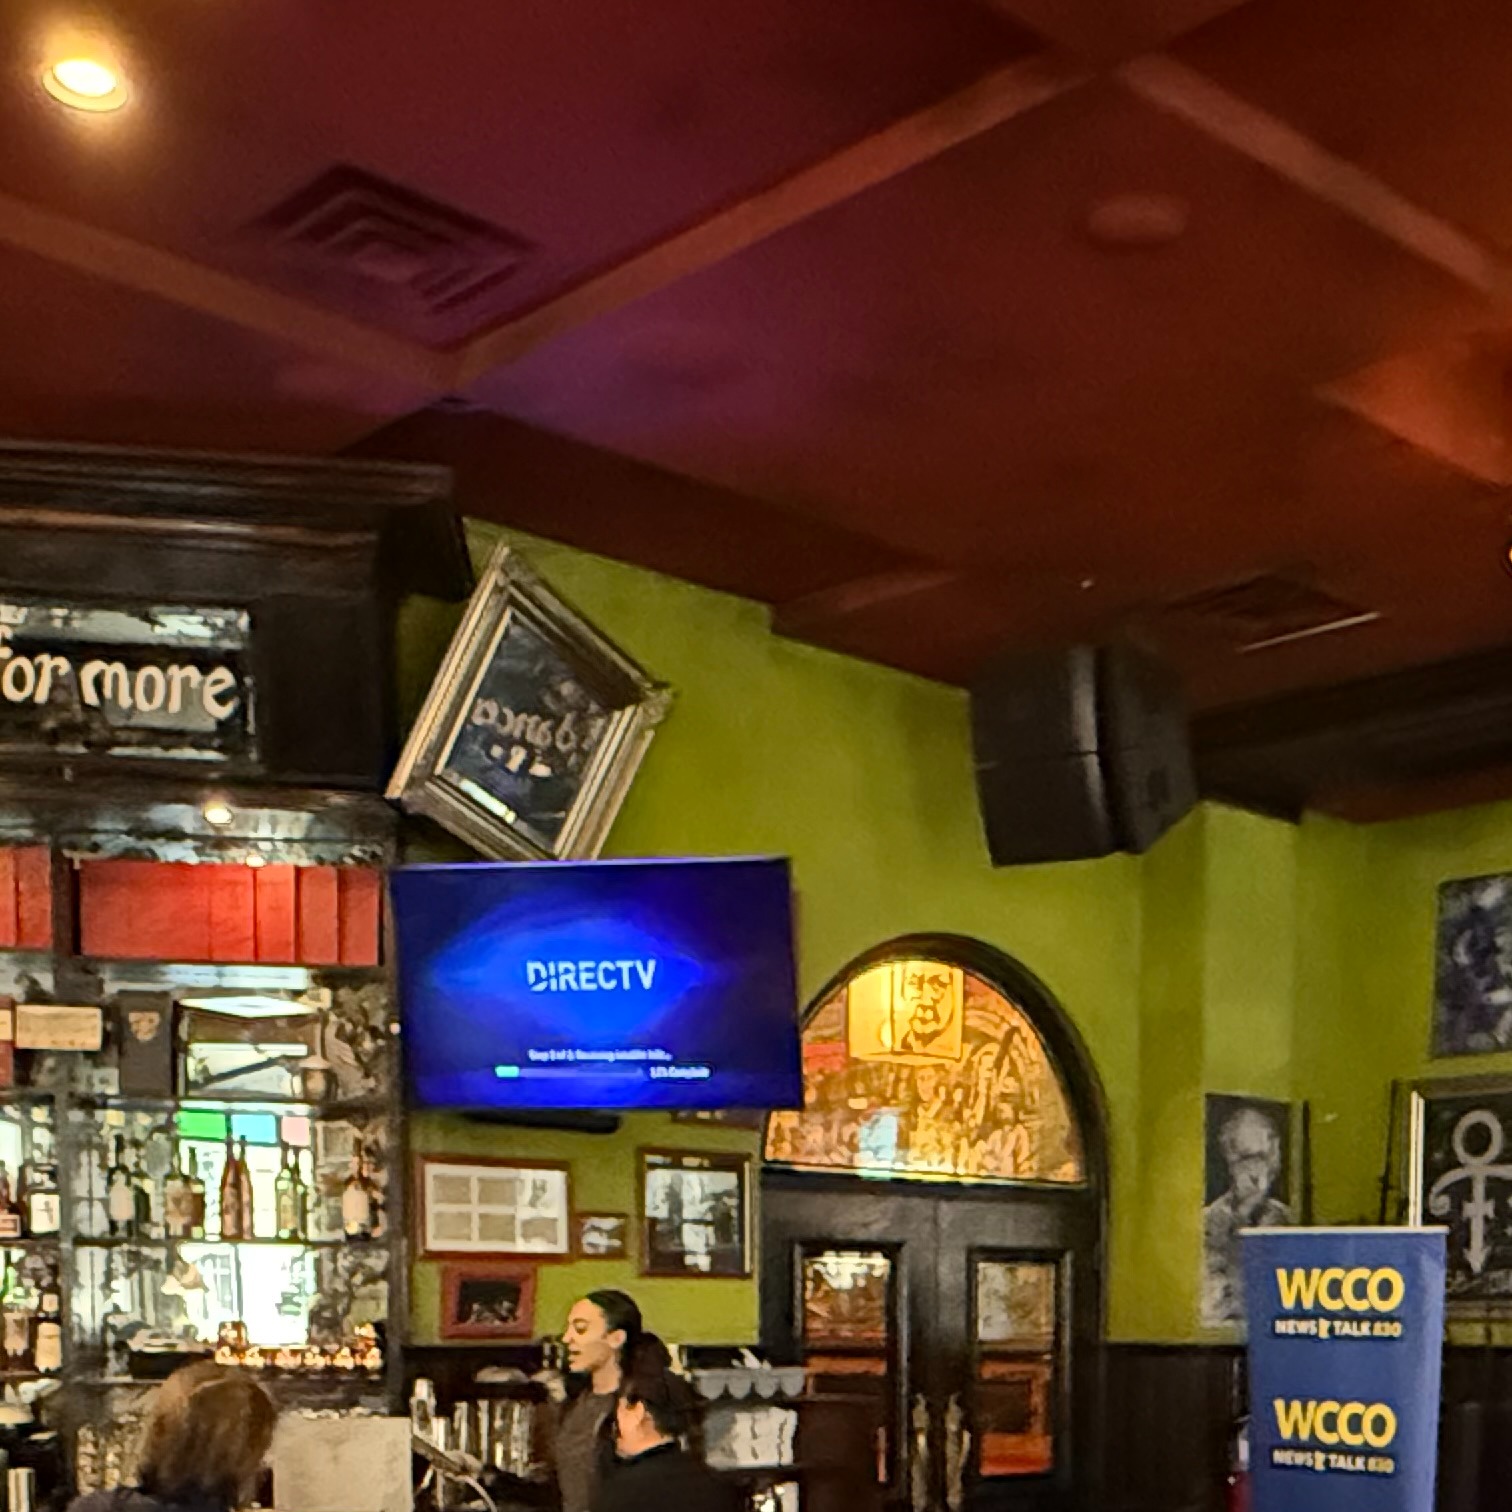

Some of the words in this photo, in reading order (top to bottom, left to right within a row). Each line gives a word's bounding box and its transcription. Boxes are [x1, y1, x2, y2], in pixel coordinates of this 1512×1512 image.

[79, 659, 240, 720] more
[526, 958, 657, 992] DIRECTV
[1275, 1266, 1406, 1313] WCCO
[1274, 1319, 1318, 1336] NEWS
[1333, 1319, 1372, 1337] TALK
[1272, 1397, 1398, 1448] WCCO
[1272, 1449, 1315, 1468] NEWS
[1328, 1453, 1366, 1473] TALK
